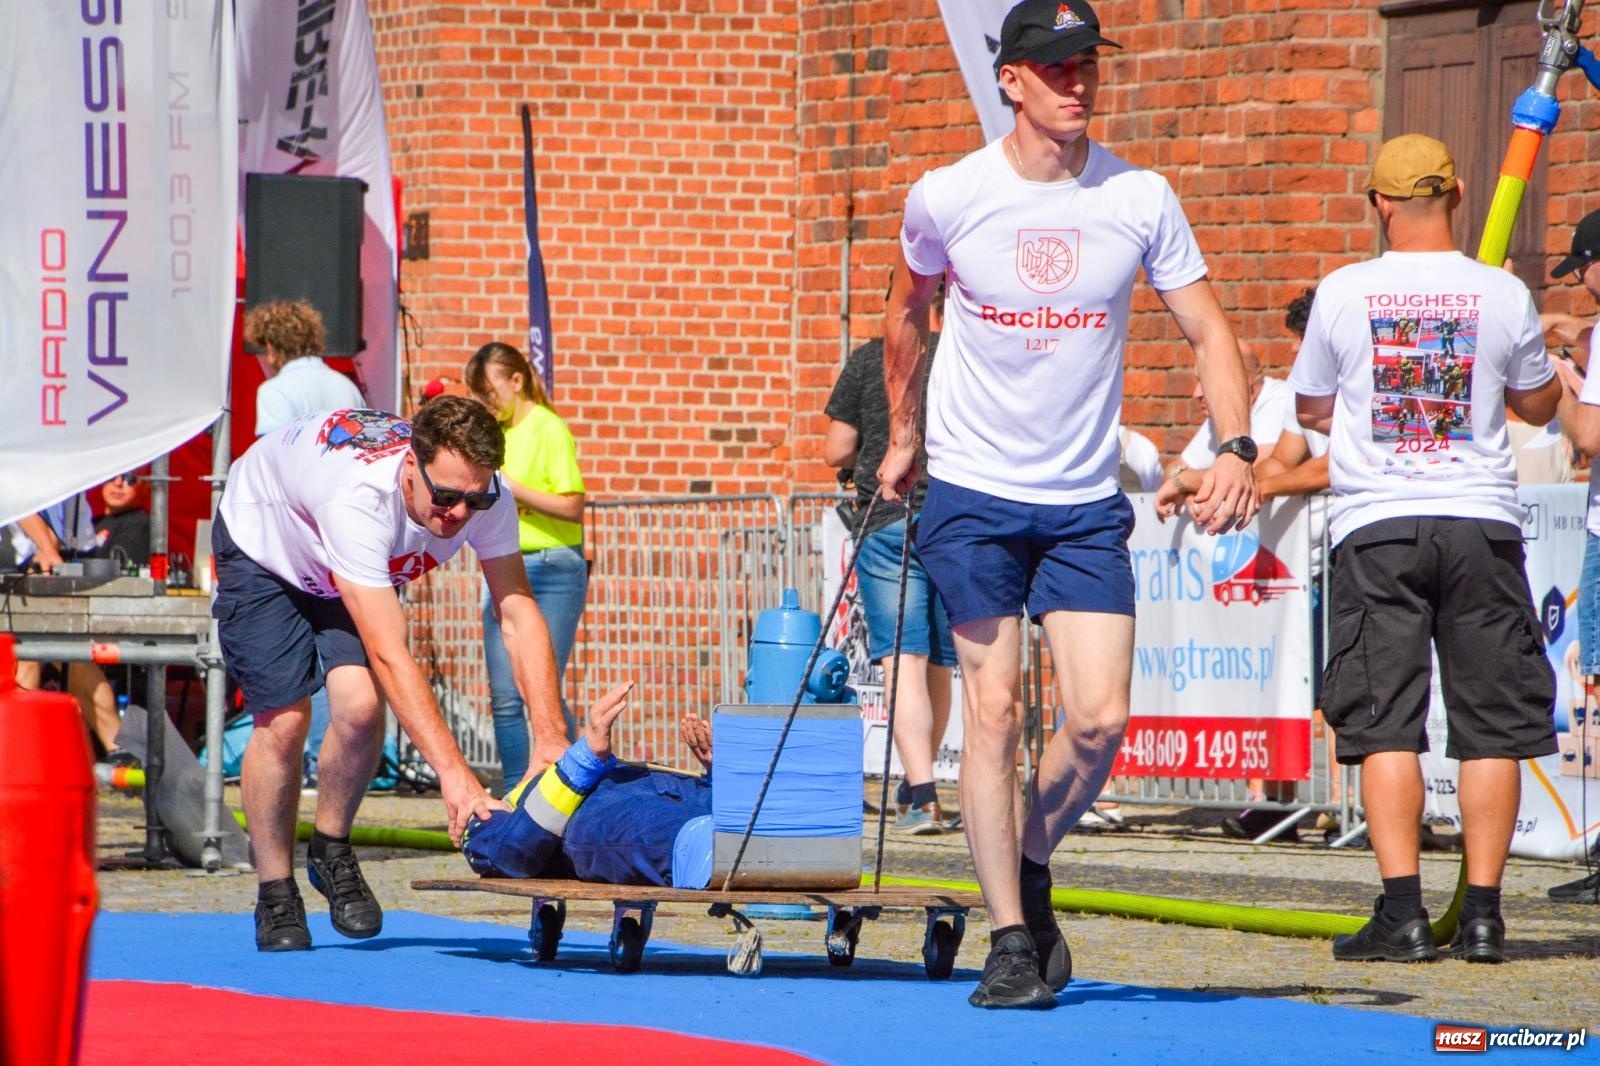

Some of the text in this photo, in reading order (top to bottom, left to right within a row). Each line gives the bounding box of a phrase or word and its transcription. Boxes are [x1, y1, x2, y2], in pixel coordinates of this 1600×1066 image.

[168, 71, 197, 299] 100,3 FM
[1364, 293, 1482, 308] TOUGHEST
[981, 304, 1108, 329] Racibórz
[1368, 309, 1480, 321] FIREFIGHTER
[41, 228, 67, 426] RADIO
[1025, 338, 1060, 356] 1217
[1395, 436, 1451, 454] 2024
[1194, 730, 1237, 768] 149
